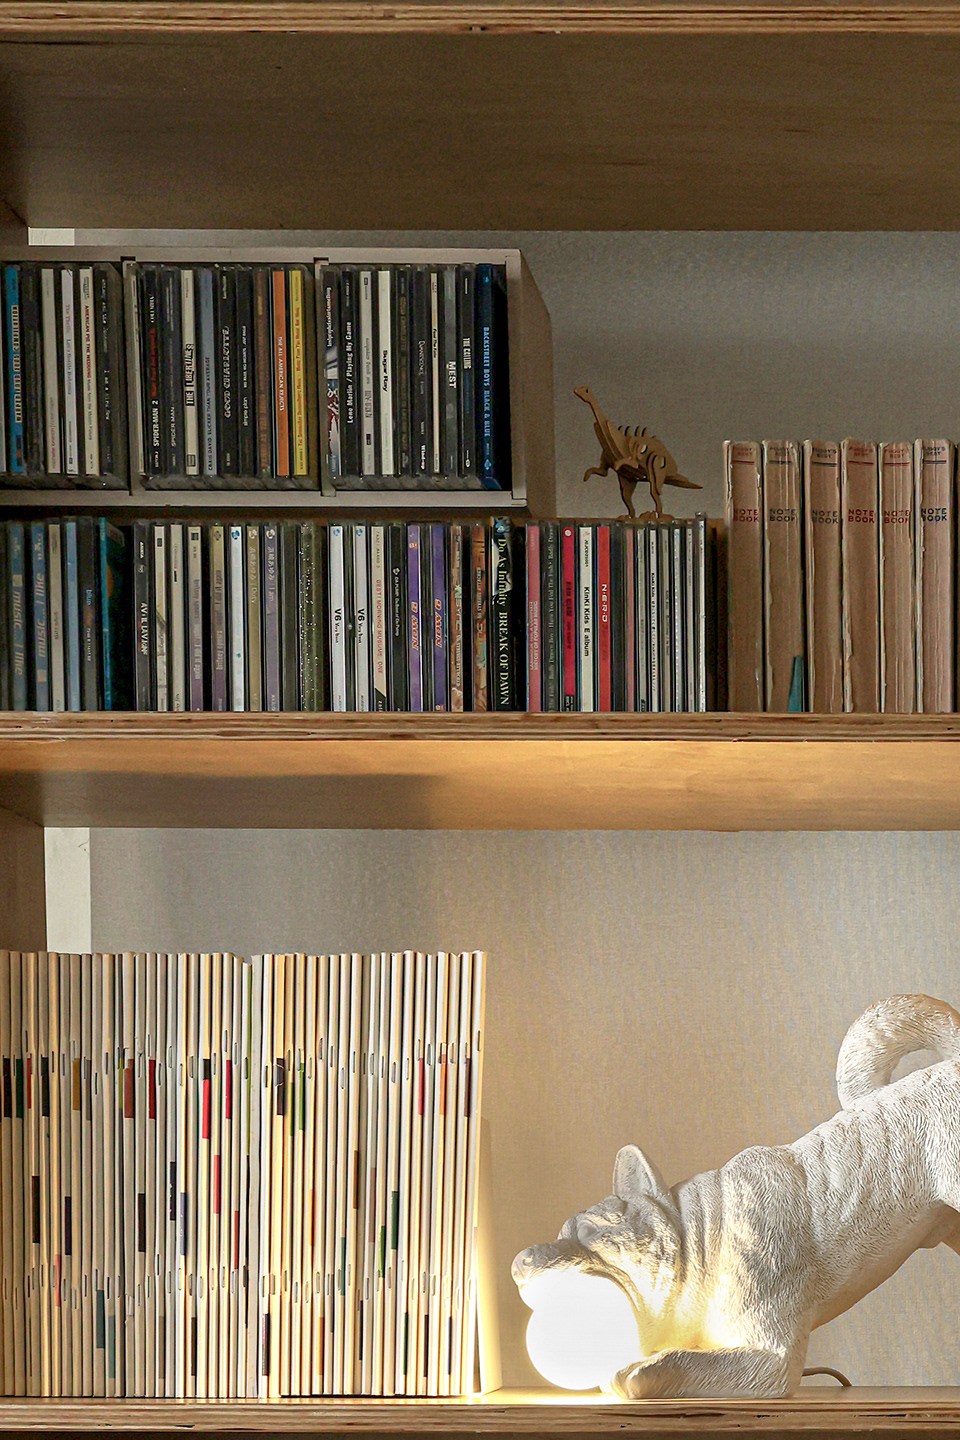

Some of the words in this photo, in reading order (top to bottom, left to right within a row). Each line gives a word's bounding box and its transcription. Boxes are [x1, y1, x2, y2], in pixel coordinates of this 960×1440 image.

[345, 341, 352, 351] My
[222, 326, 230, 388] CHARLOTTE
[184, 344, 194, 388] LIBERTINES
[447, 361, 456, 388] MEST
[185, 391, 194, 406] THE
[223, 391, 231, 418] GOOD
[152, 408, 160, 446] SPIDER-MAN
[769, 508, 796, 516] NOTE
[848, 508, 875, 517] NOTE
[848, 515, 875, 523] BOOK
[921, 514, 948, 522] BOOK
[498, 538, 505, 552] Do
[498, 556, 505, 567] As
[35, 573, 44, 596] like
[334, 609, 341, 621] V6
[357, 609, 365, 621] V6
[499, 612, 508, 651] BREAK
[15, 652, 23, 675] like
[499, 654, 508, 669] OF
[500, 672, 509, 705] DAWN
